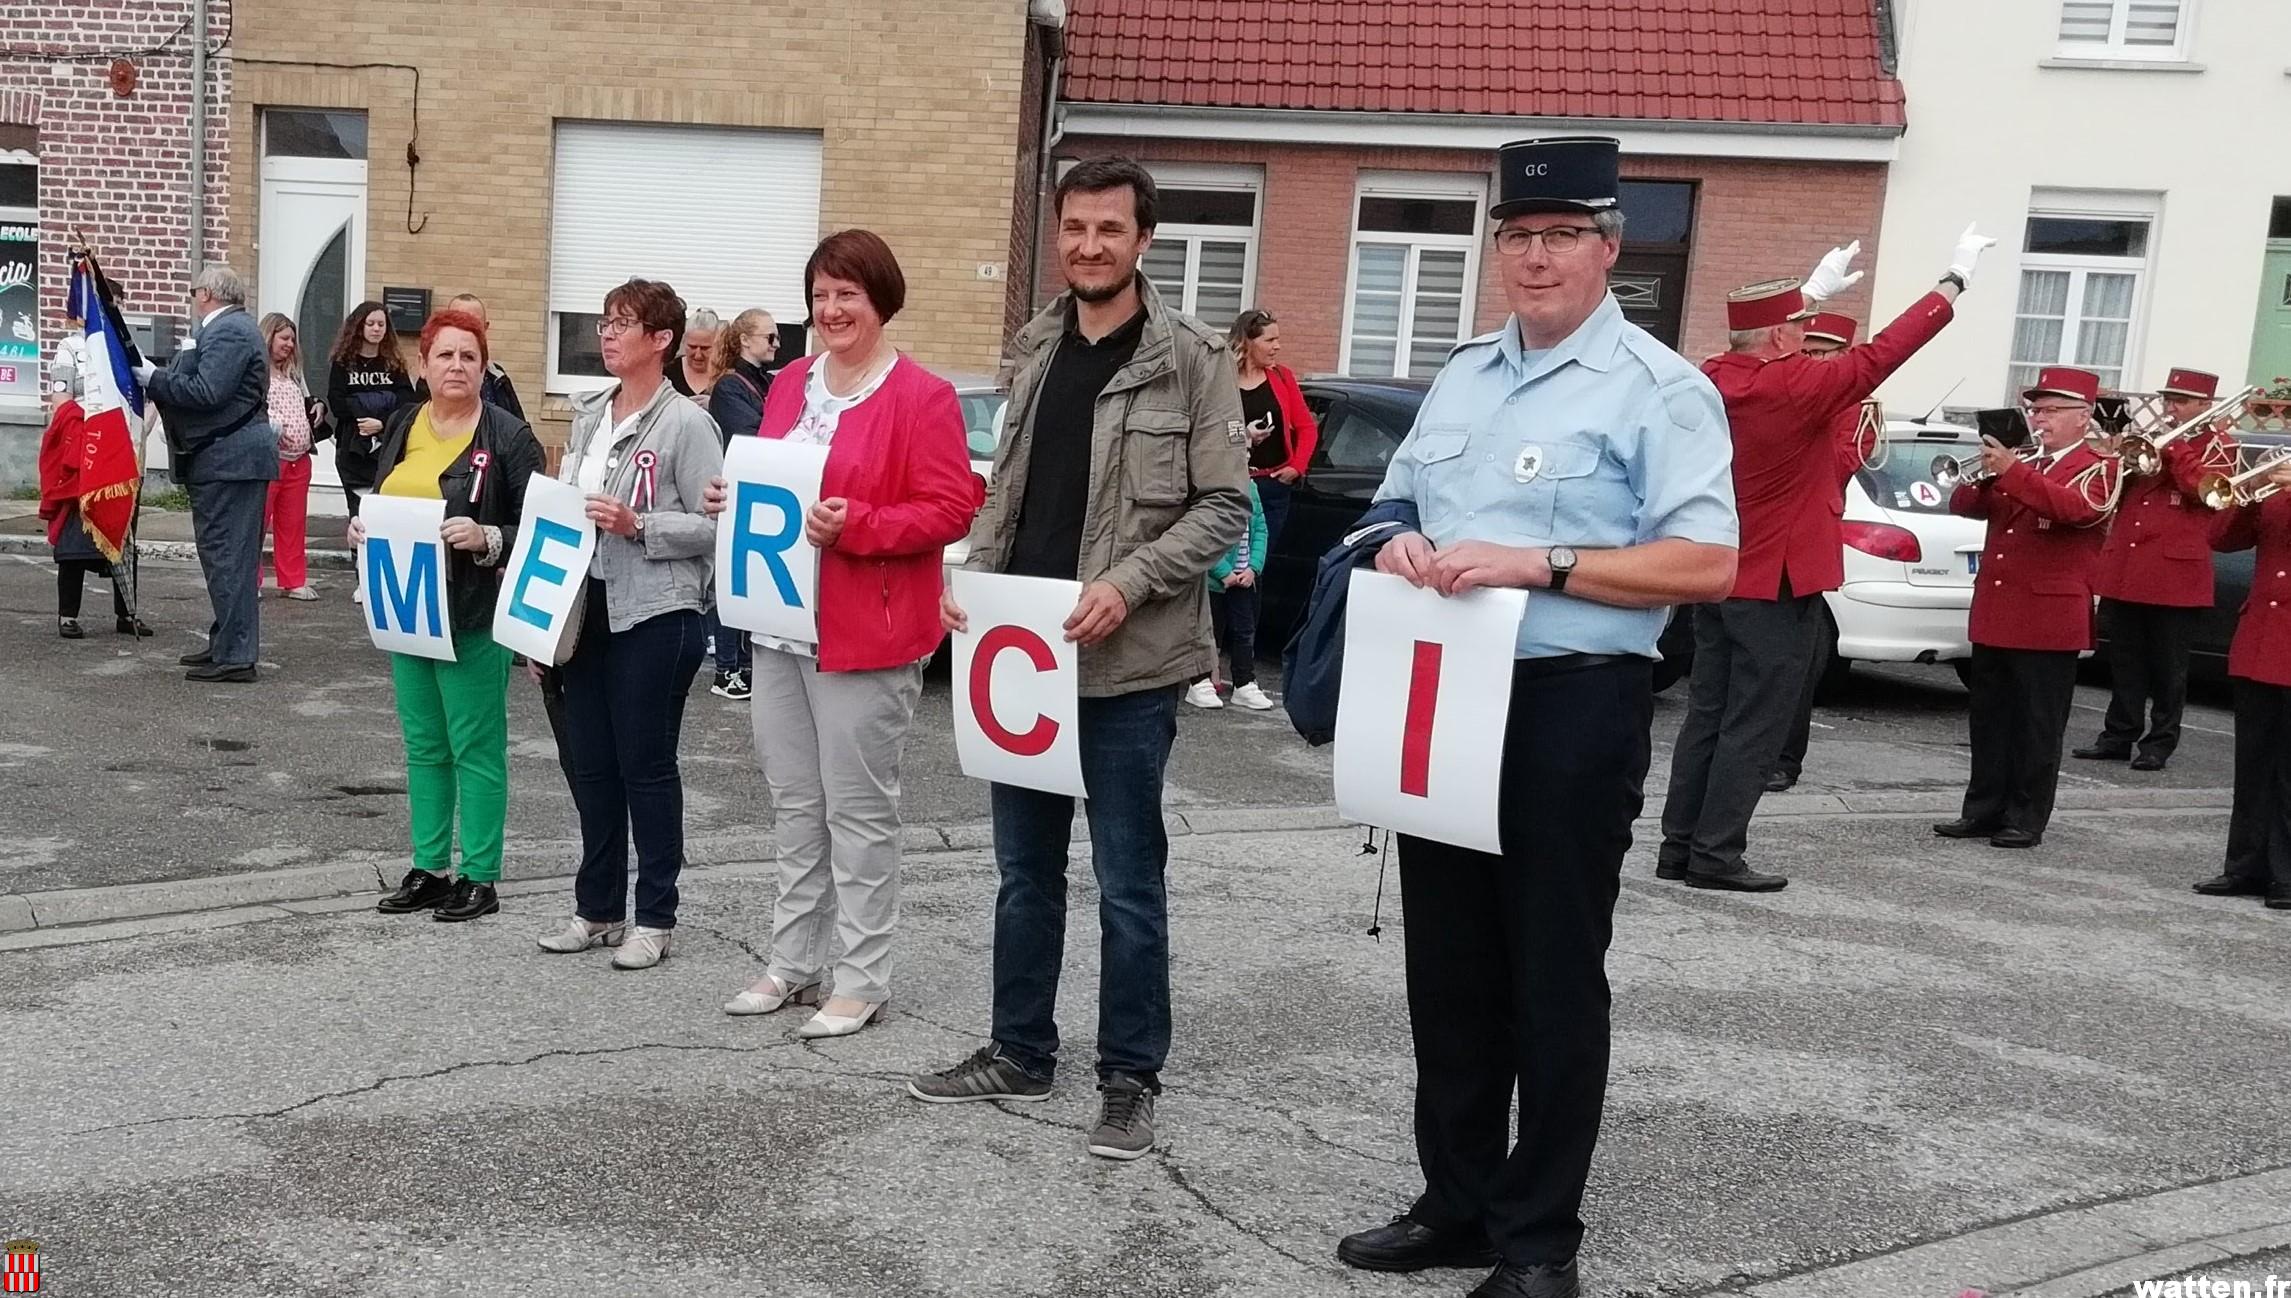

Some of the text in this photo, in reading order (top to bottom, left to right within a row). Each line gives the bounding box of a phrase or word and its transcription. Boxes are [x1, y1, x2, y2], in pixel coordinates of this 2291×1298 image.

[1525, 163, 1548, 177] GC
[347, 371, 394, 386] ROCK
[731, 480, 805, 609] R
[1919, 484, 1936, 501] A
[366, 537, 443, 638] M
[508, 517, 582, 631] E
[969, 624, 1060, 757] C
[1400, 639, 1443, 798] I
